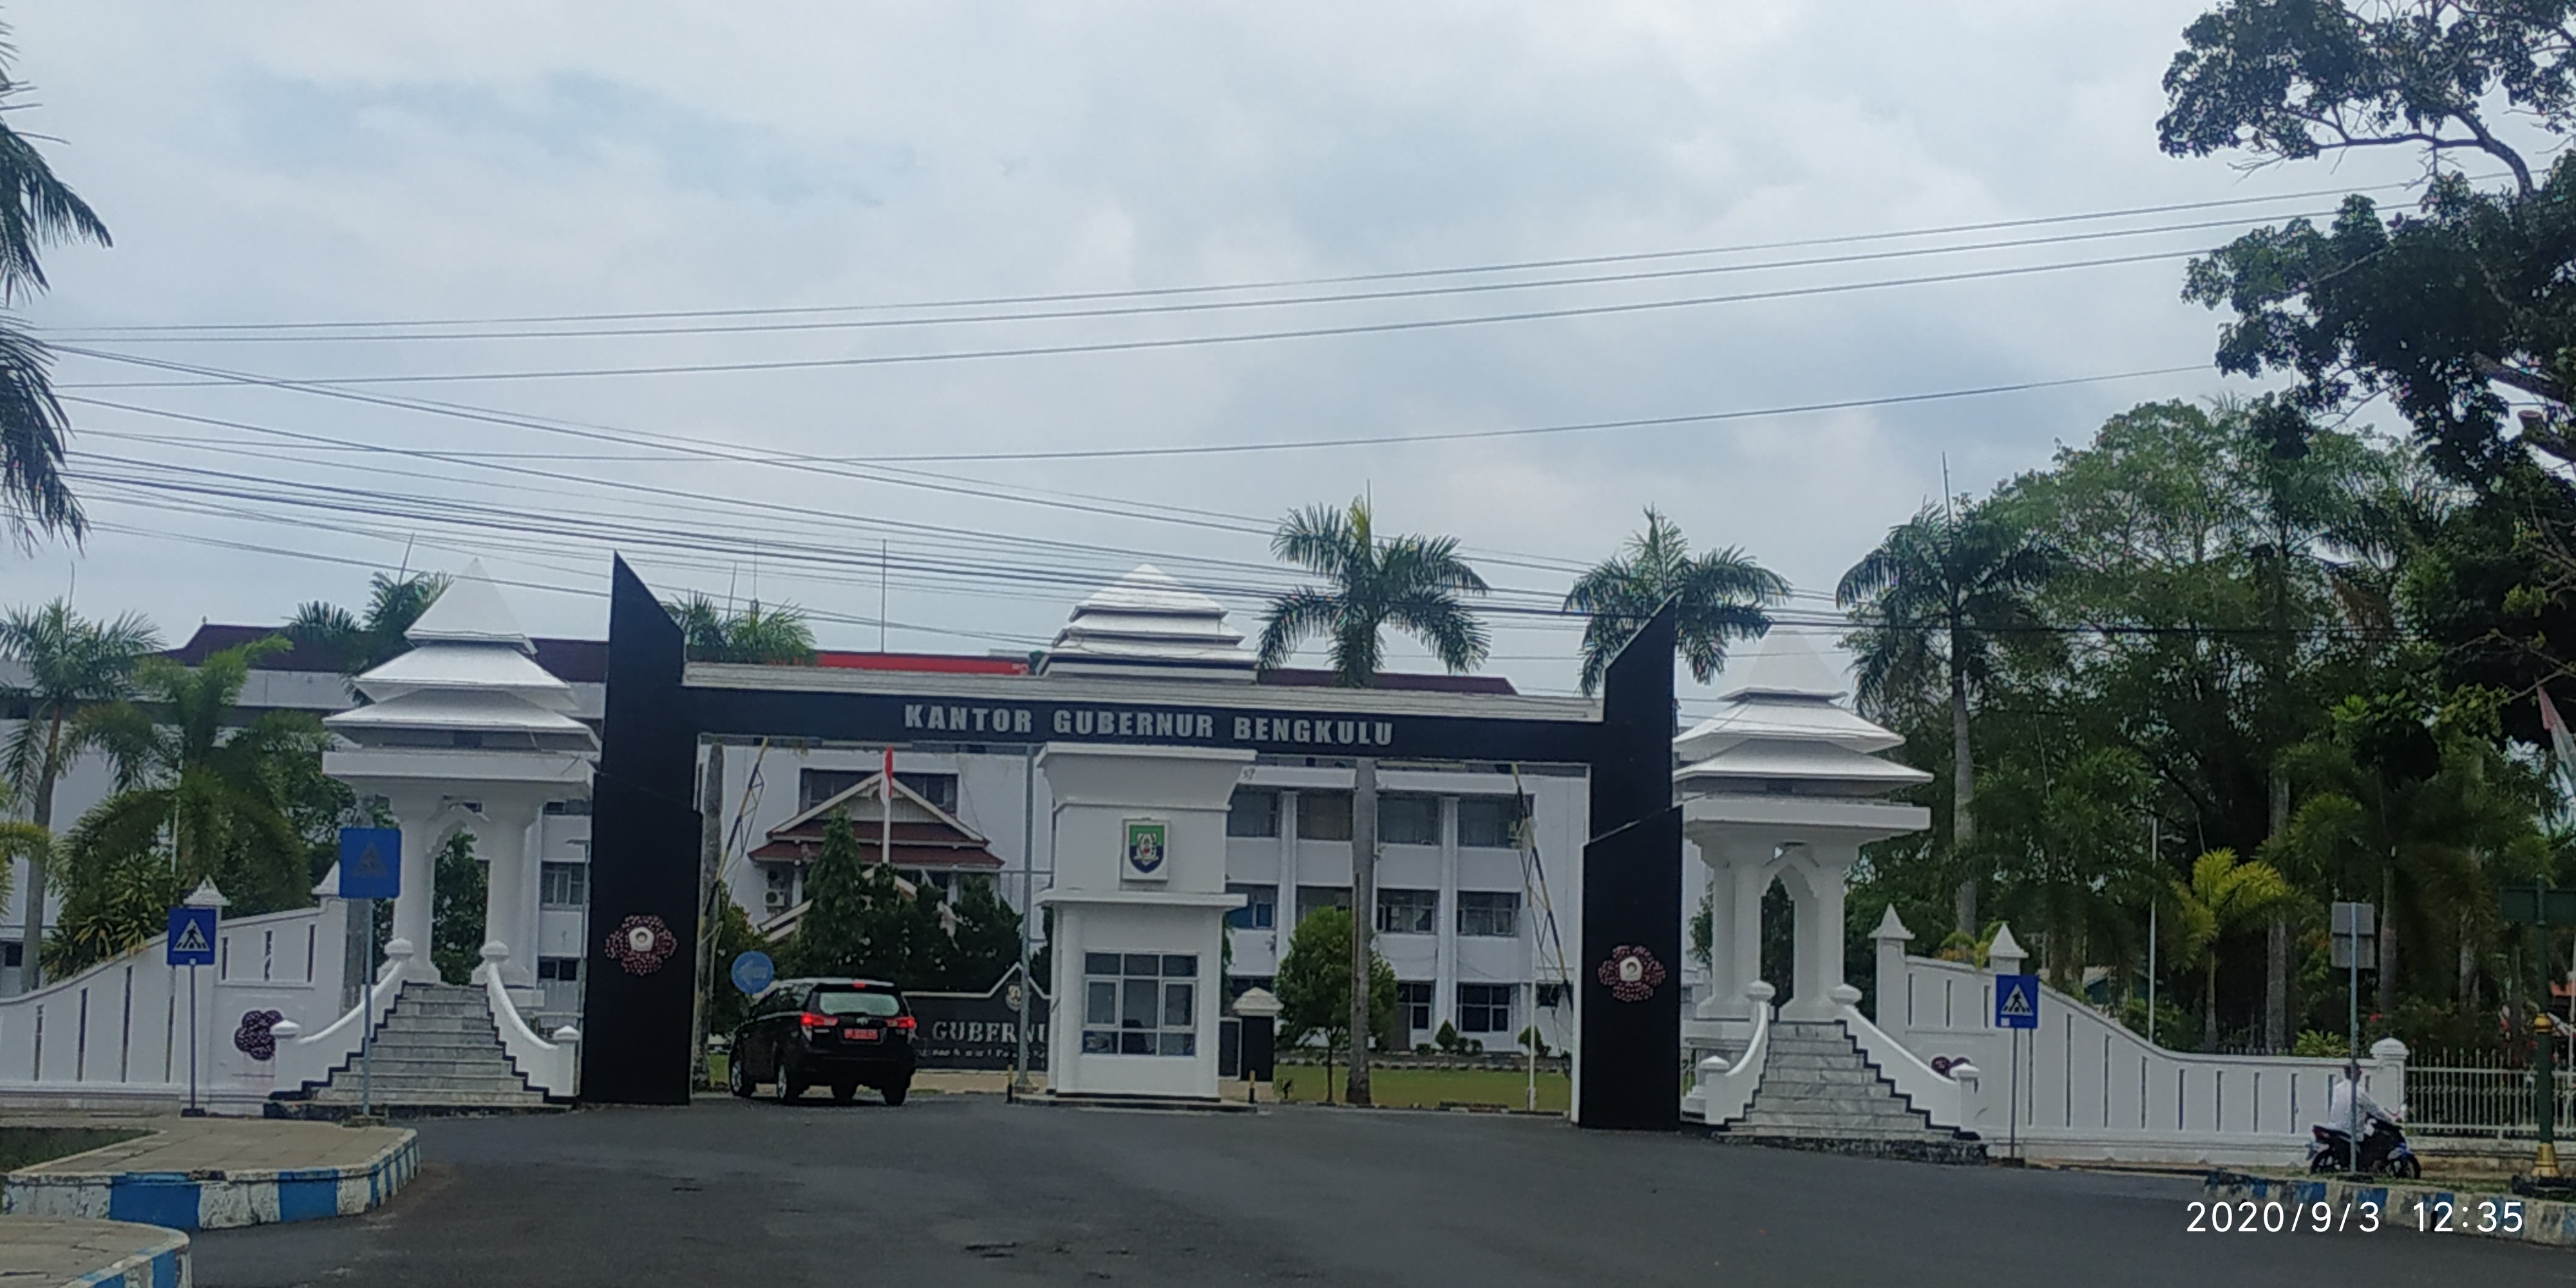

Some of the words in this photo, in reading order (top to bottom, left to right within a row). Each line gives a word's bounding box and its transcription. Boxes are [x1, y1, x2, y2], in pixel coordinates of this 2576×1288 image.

[904, 704, 1032, 733] KANTOR
[1053, 709, 1213, 738] GUBERNUR
[1233, 716, 1393, 746] BENGKULU
